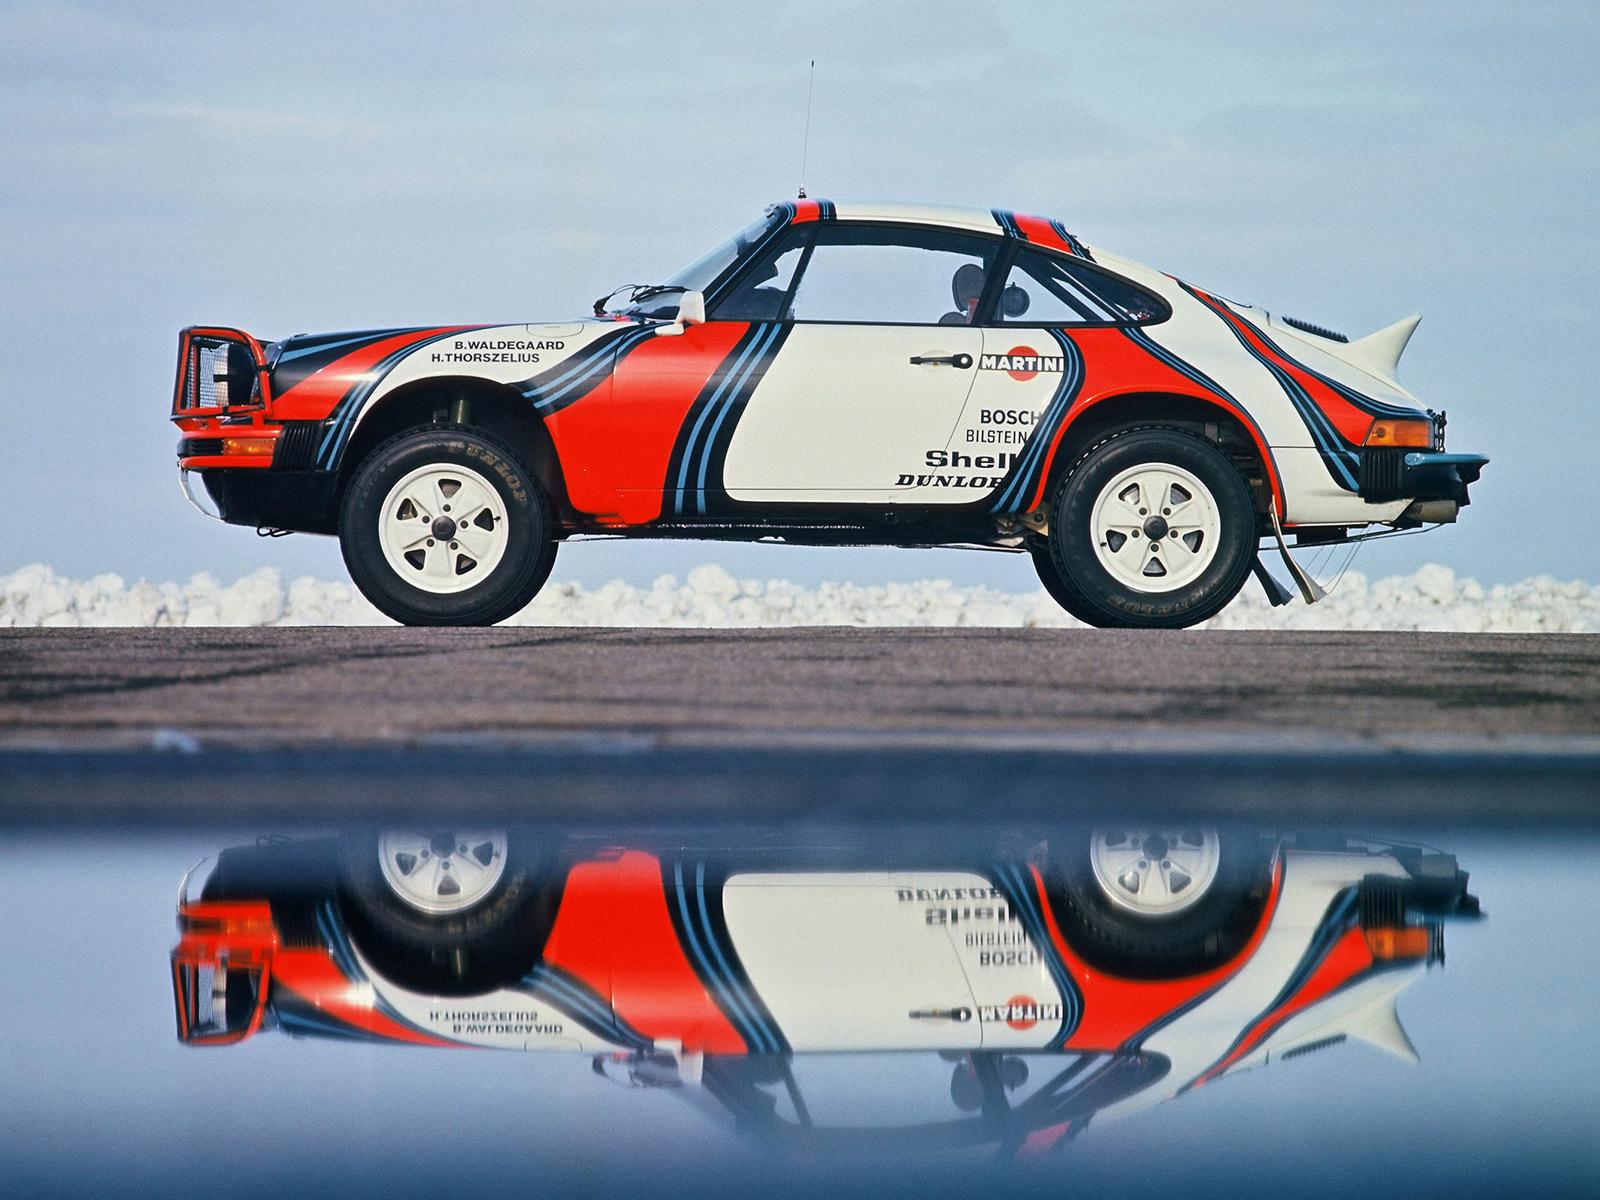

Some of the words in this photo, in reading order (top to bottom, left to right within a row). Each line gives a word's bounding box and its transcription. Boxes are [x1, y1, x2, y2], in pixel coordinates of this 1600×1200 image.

[455, 341, 565, 350] B.WALDEGAARD
[431, 353, 540, 362] H.THORSZELIUS
[981, 354, 1064, 371] MARTINI
[980, 410, 1042, 425] BOSCH
[966, 429, 1028, 444] BILSTEIN
